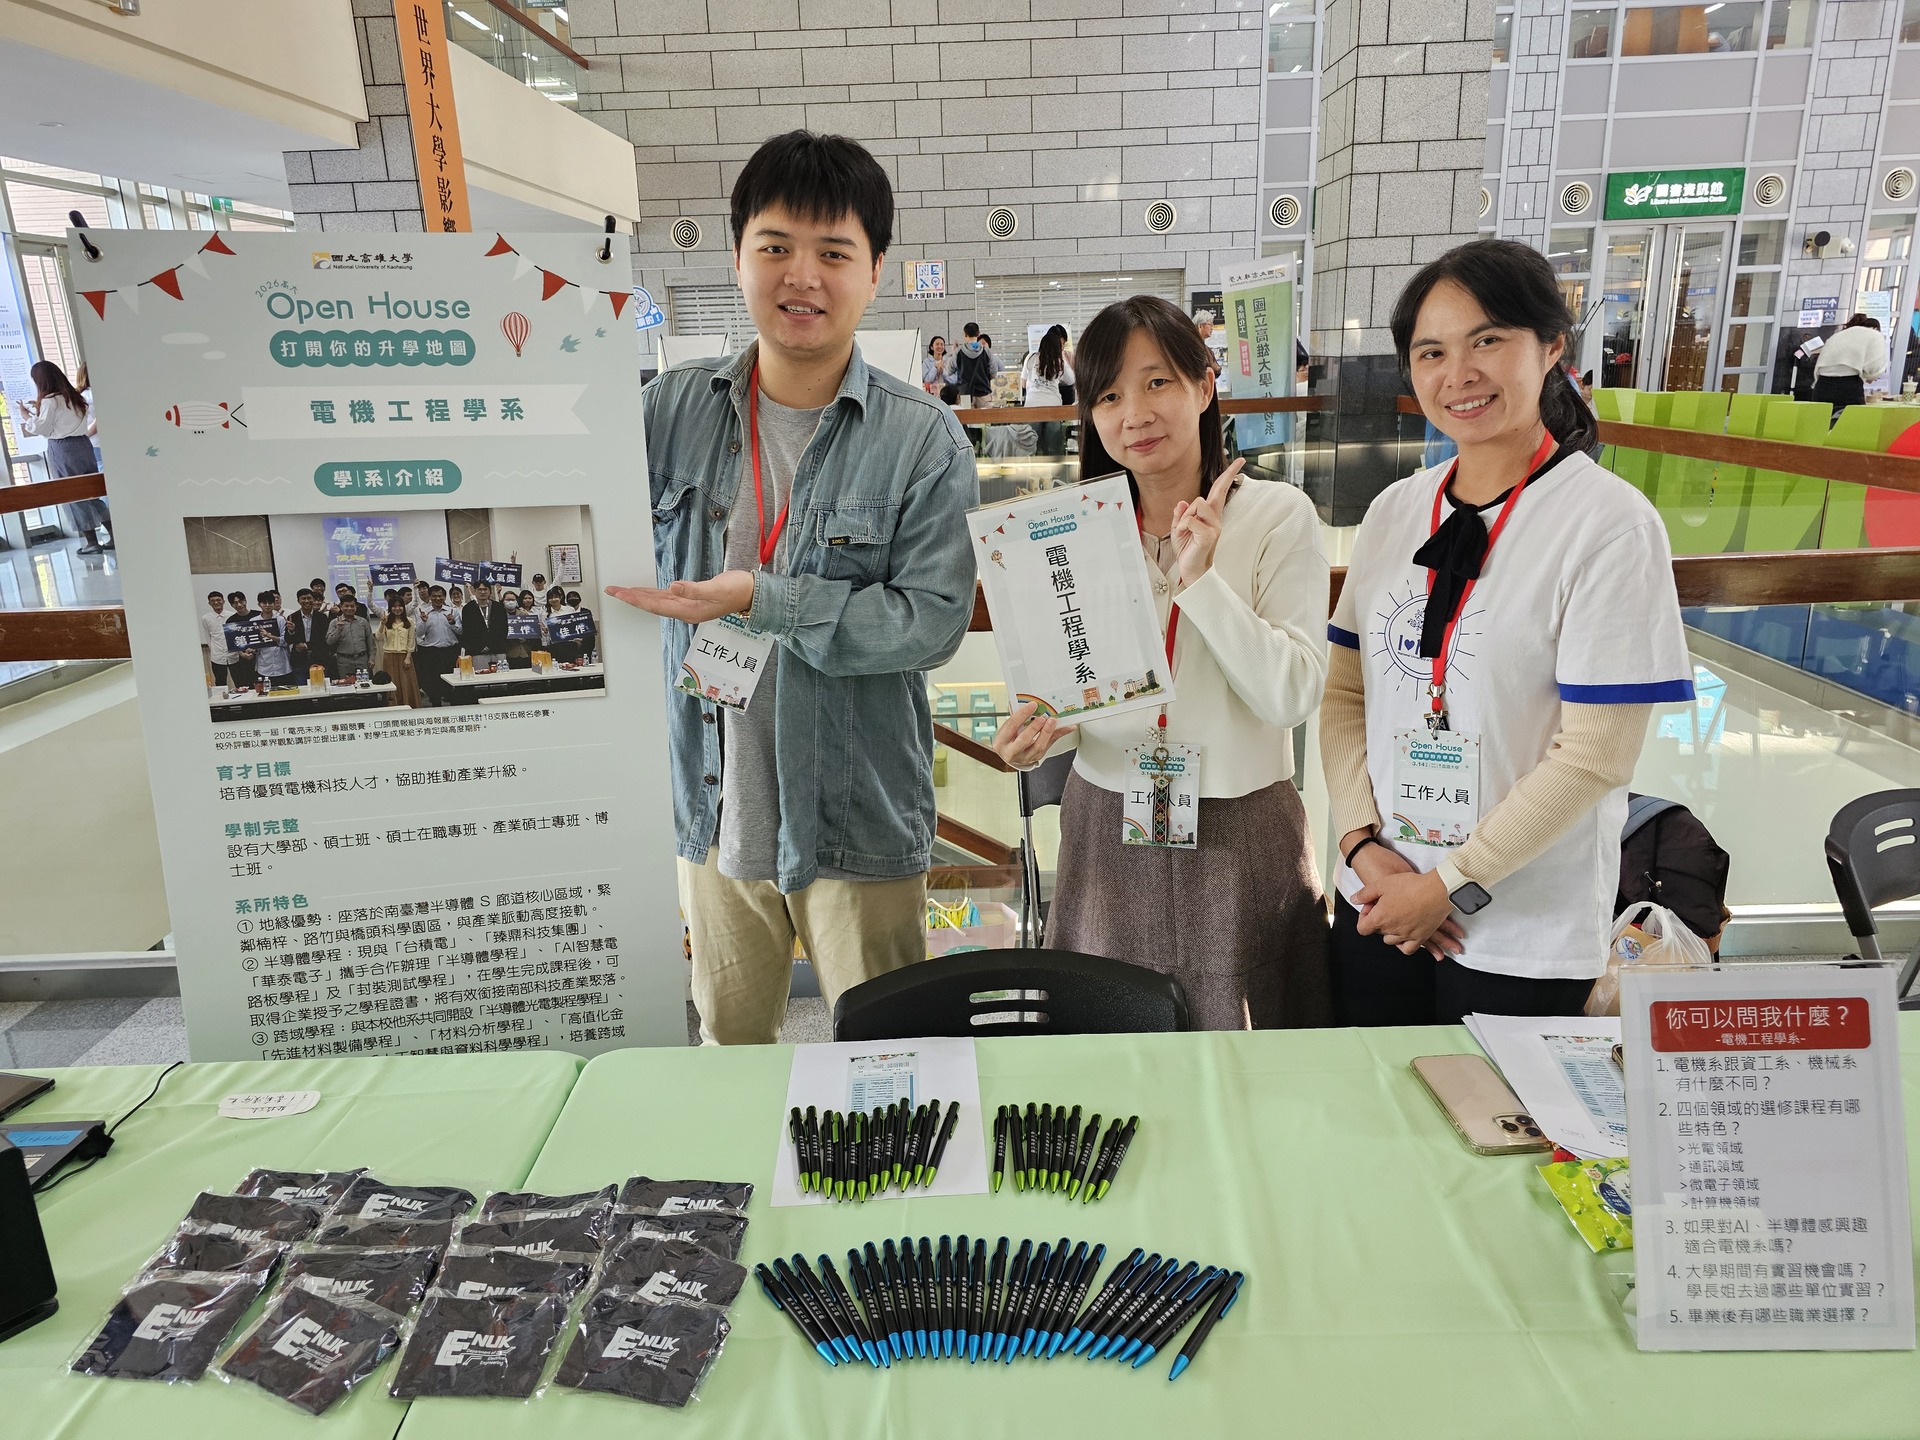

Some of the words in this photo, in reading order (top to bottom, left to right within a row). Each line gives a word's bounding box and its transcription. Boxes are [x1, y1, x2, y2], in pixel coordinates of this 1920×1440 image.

[331, 253, 413, 264] 國立高雄大學
[267, 291, 354, 325] Open
[368, 291, 471, 320] House
[280, 340, 467, 358] 打開你的升學地圖
[310, 398, 525, 424] 電機工程學系
[1028, 520, 1048, 530] Open
[1050, 513, 1075, 524] House
[1045, 544, 1097, 685] 電機工程學系
[696, 638, 758, 673] 工作人員
[214, 731, 237, 740] 2025
[1411, 741, 1433, 750] Open
[1436, 743, 1463, 752] House
[216, 761, 292, 781] 育才目標
[219, 764, 528, 801] 培育優質電機科技人才，協助推動產業升級。
[1400, 783, 1471, 806] 工作人員
[225, 818, 300, 839] 學制完整
[229, 862, 273, 878] 士班。
[235, 894, 309, 915] 系所特色
[481, 895, 491, 907] S
[1665, 1005, 1850, 1030] 你可以問我什麼？
[1656, 1058, 1669, 1072] 1.
[1674, 1054, 1858, 1073] 電機系跟資工系、機械系
[1675, 1075, 1771, 1092] 有什麼不同？
[1658, 1102, 1672, 1117] 2.
[1677, 1098, 1862, 1118] 四個領域的選修課程有哪
[1678, 1121, 1741, 1137] 些特色？
[1665, 1220, 1679, 1234] 3.
[1684, 1217, 1868, 1235] 如果對AI、半導體感興趣
[1667, 1265, 1681, 1279] 4.
[1685, 1262, 1867, 1279] 大學期間有實習機會嗎？
[1686, 1282, 1885, 1299] 學長姐去過哪些單位實習？
[1670, 1309, 1682, 1324] 5.
[1687, 1307, 1869, 1324] 畢業後有哪些職業選擇？
